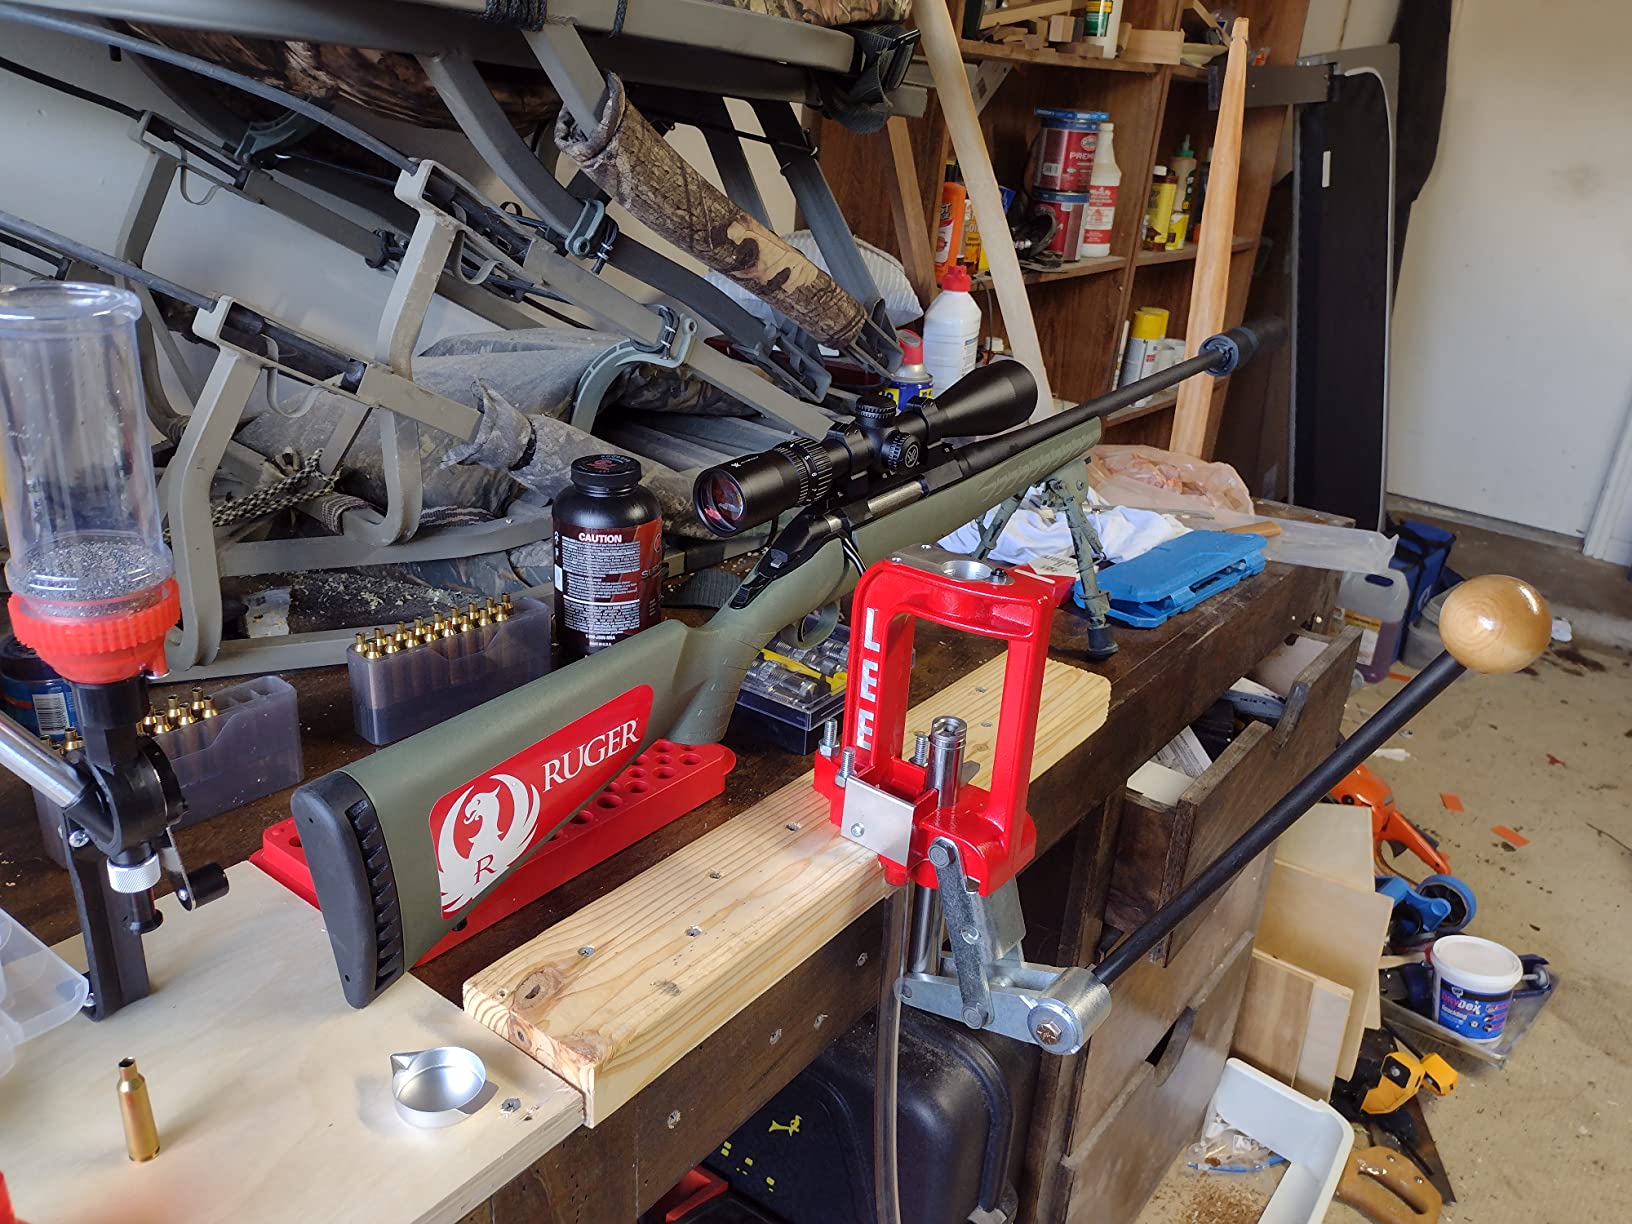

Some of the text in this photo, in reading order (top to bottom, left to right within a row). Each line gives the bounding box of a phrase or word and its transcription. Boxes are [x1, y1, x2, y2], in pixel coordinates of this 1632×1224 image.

[1069, 151, 1094, 160] PREM
[578, 532, 623, 543] CAUTION
[856, 607, 880, 751] LEE
[542, 719, 639, 793] RUGER
[474, 854, 496, 885] R
